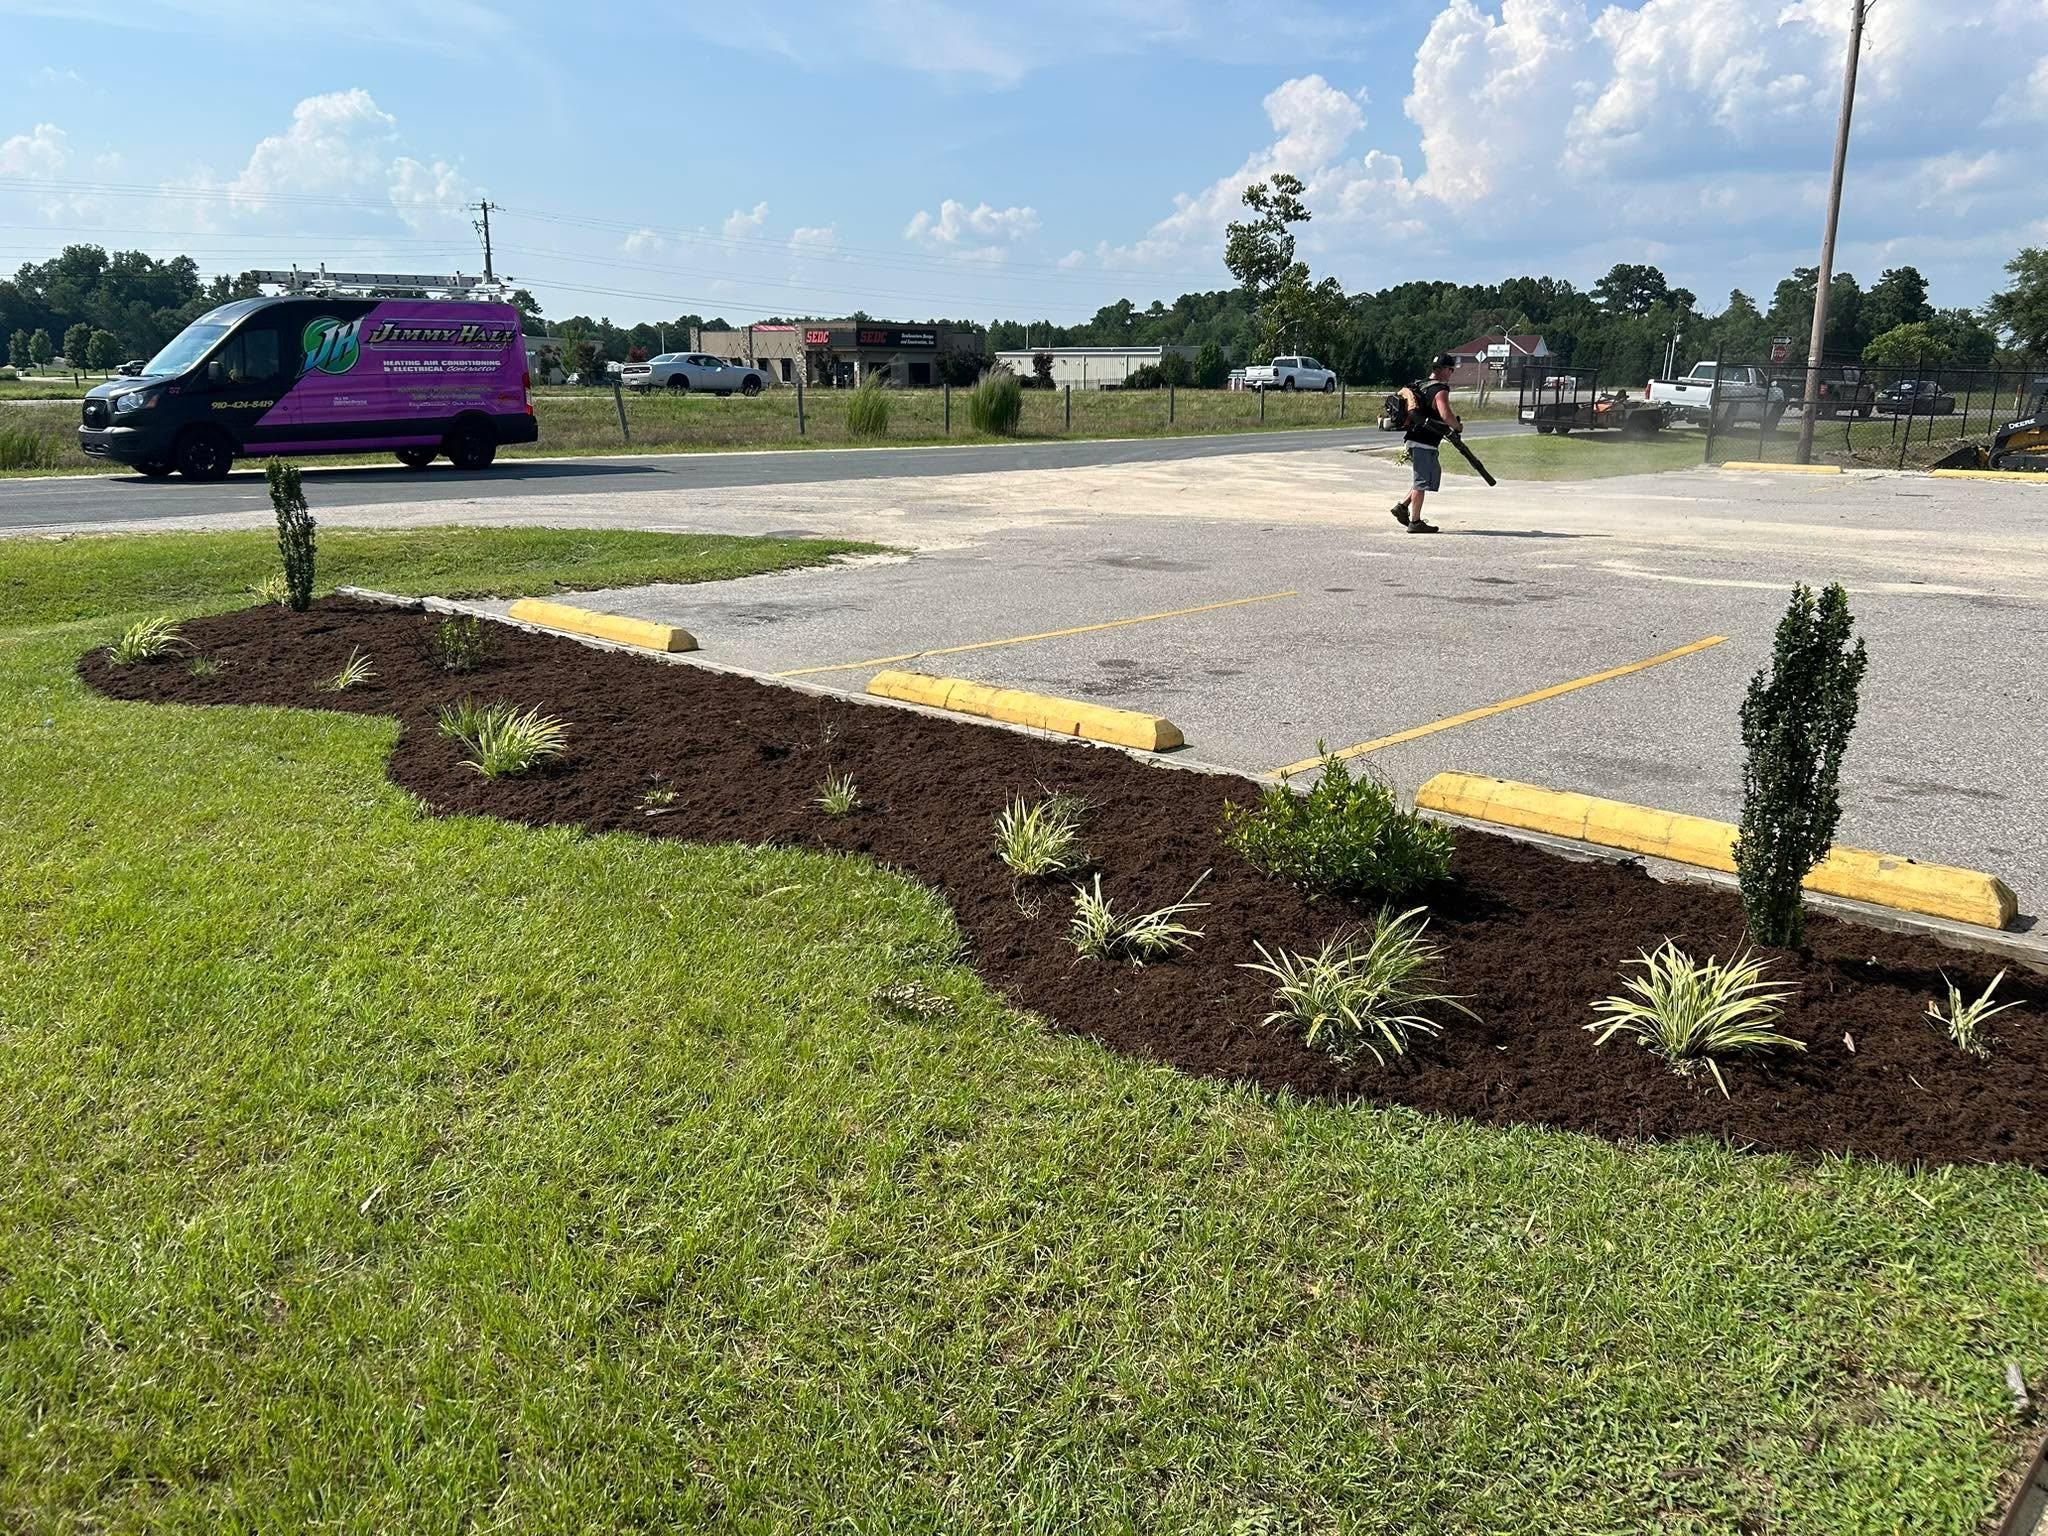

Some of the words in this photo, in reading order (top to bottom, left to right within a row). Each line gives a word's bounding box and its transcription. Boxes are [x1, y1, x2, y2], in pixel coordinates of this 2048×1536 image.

[806, 331, 830, 343] SEDC
[860, 331, 888, 343] SEDC
[211, 400, 274, 409] 910-424-8419
[2008, 418, 2036, 430] DEERE
